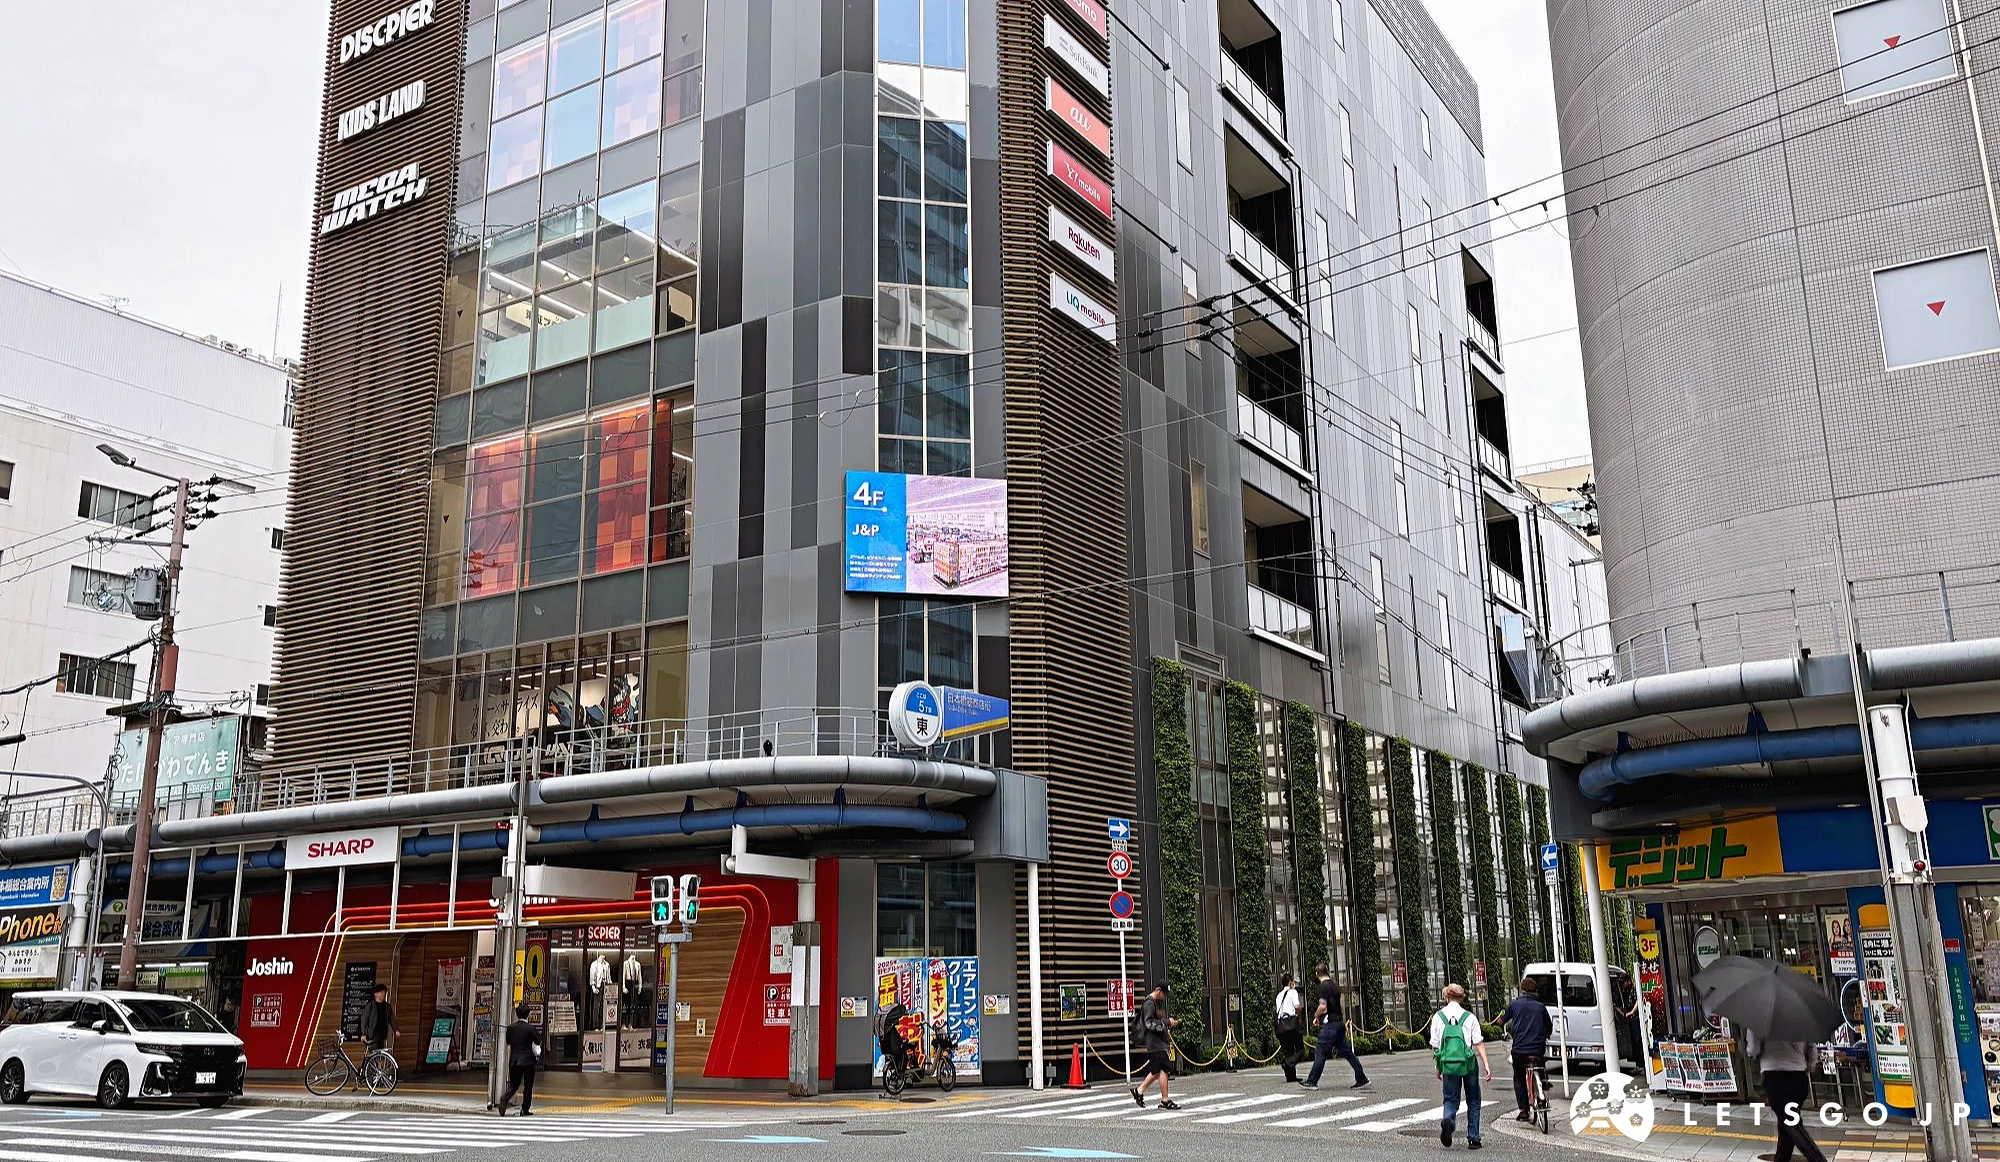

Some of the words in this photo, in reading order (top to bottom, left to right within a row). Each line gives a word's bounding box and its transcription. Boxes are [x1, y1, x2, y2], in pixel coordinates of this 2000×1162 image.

[1068, 45, 1099, 80] SoftBank
[337, 100, 377, 142] KIDS
[378, 79, 426, 126] LAND
[1069, 106, 1092, 132] au
[332, 162, 419, 213] MEGA
[1078, 178, 1101, 202] mobile
[320, 177, 429, 235] WATCH
[1068, 226, 1101, 262] Rakuten
[1066, 290, 1080, 312] UQ
[1080, 304, 1106, 327] mobile
[853, 481, 884, 506] 4F
[852, 524, 880, 537] J&P
[916, 717, 928, 736] 東
[307, 838, 375, 859] SHARP
[1609, 827, 1747, 889] デジット
[1113, 859, 1127, 871] 30
[1641, 938, 1656, 953] 3F
[247, 957, 294, 977] Joshin
[770, 988, 776, 999] P
[962, 960, 977, 1015] エアコン
